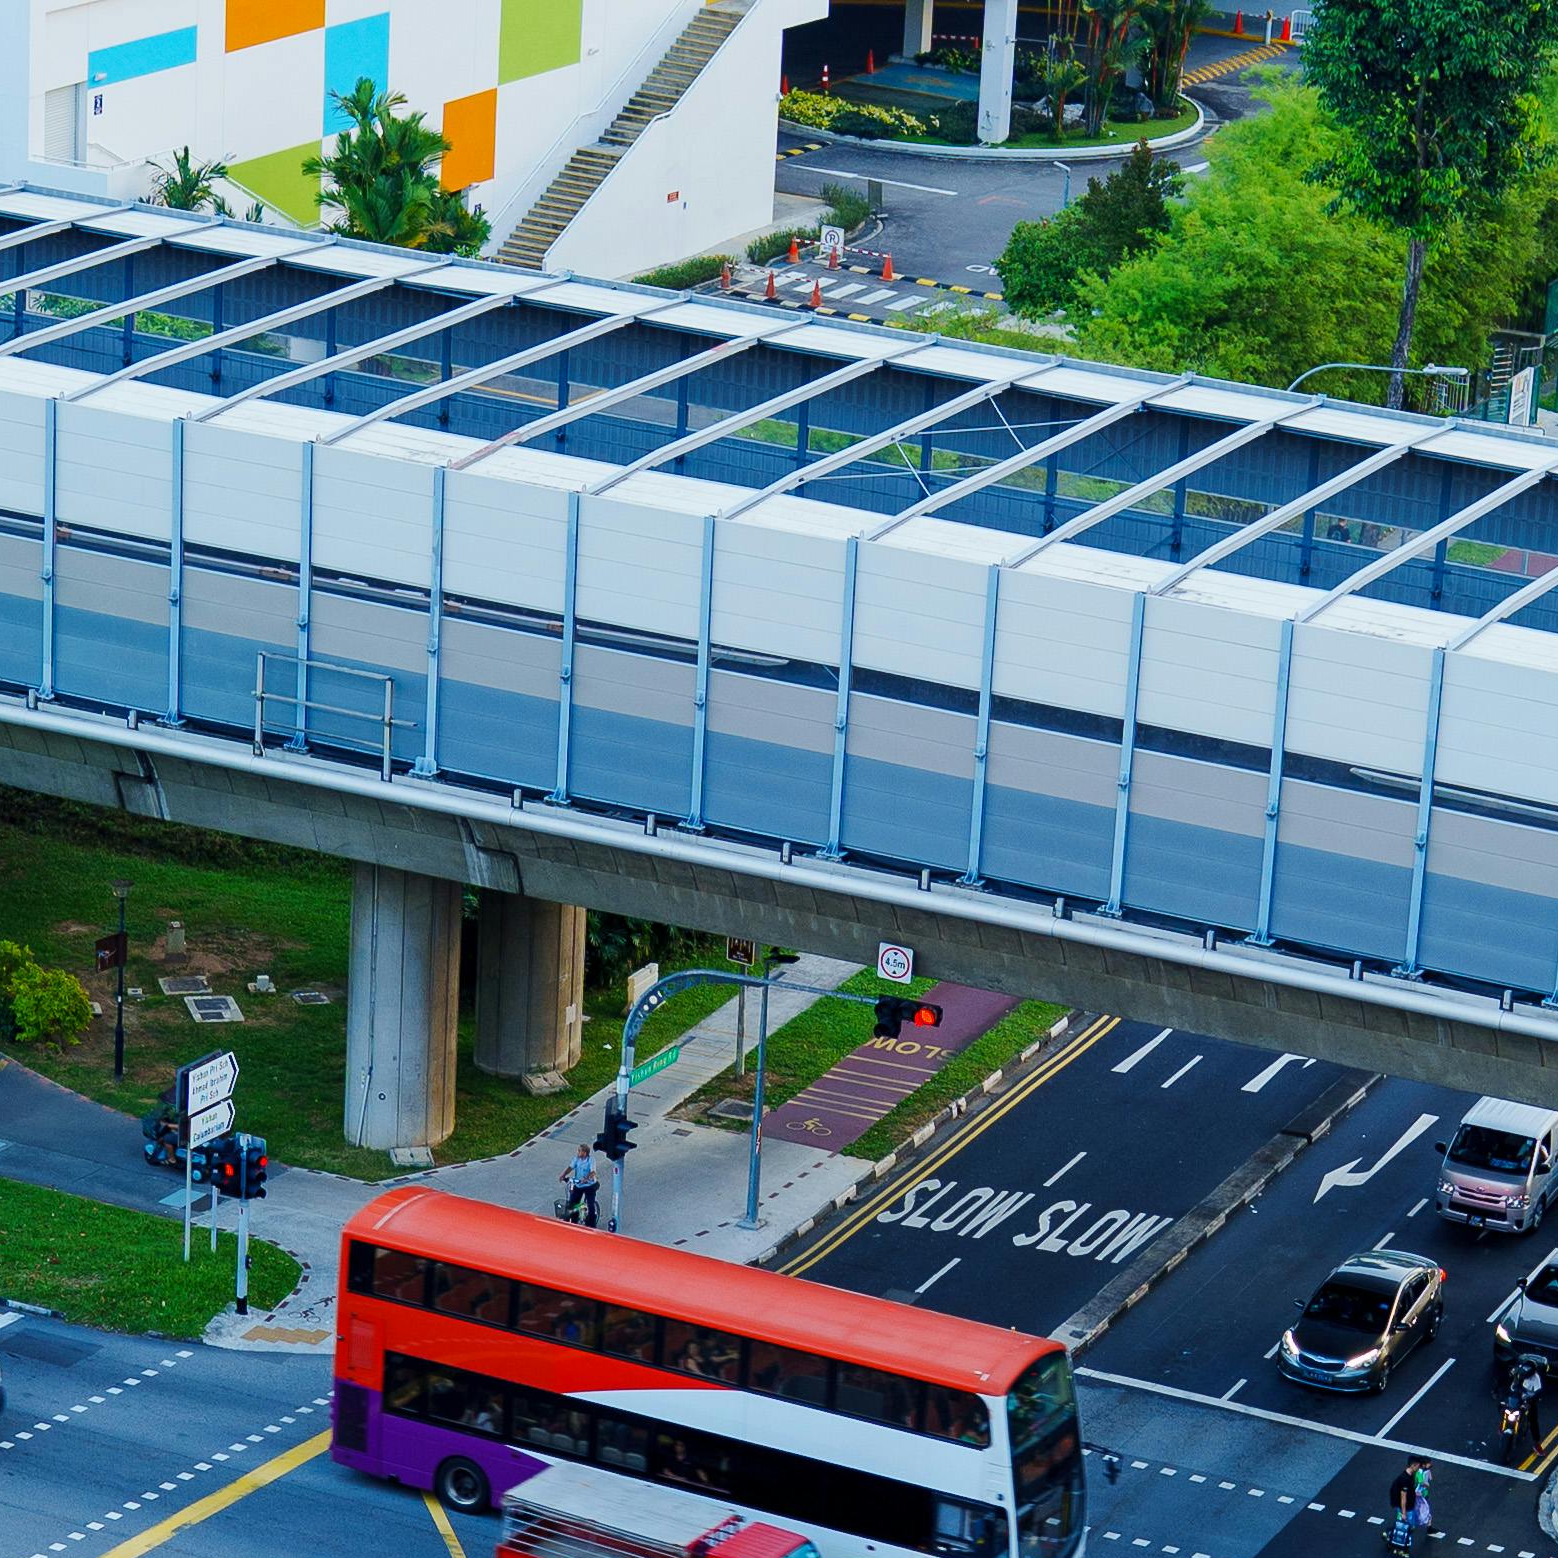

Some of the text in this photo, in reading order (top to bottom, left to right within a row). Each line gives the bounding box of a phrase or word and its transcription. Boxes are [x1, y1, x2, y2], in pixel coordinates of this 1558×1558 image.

[884, 956, 906, 970] 4.5m
[876, 1179, 1174, 1264] SLOW SLOW
